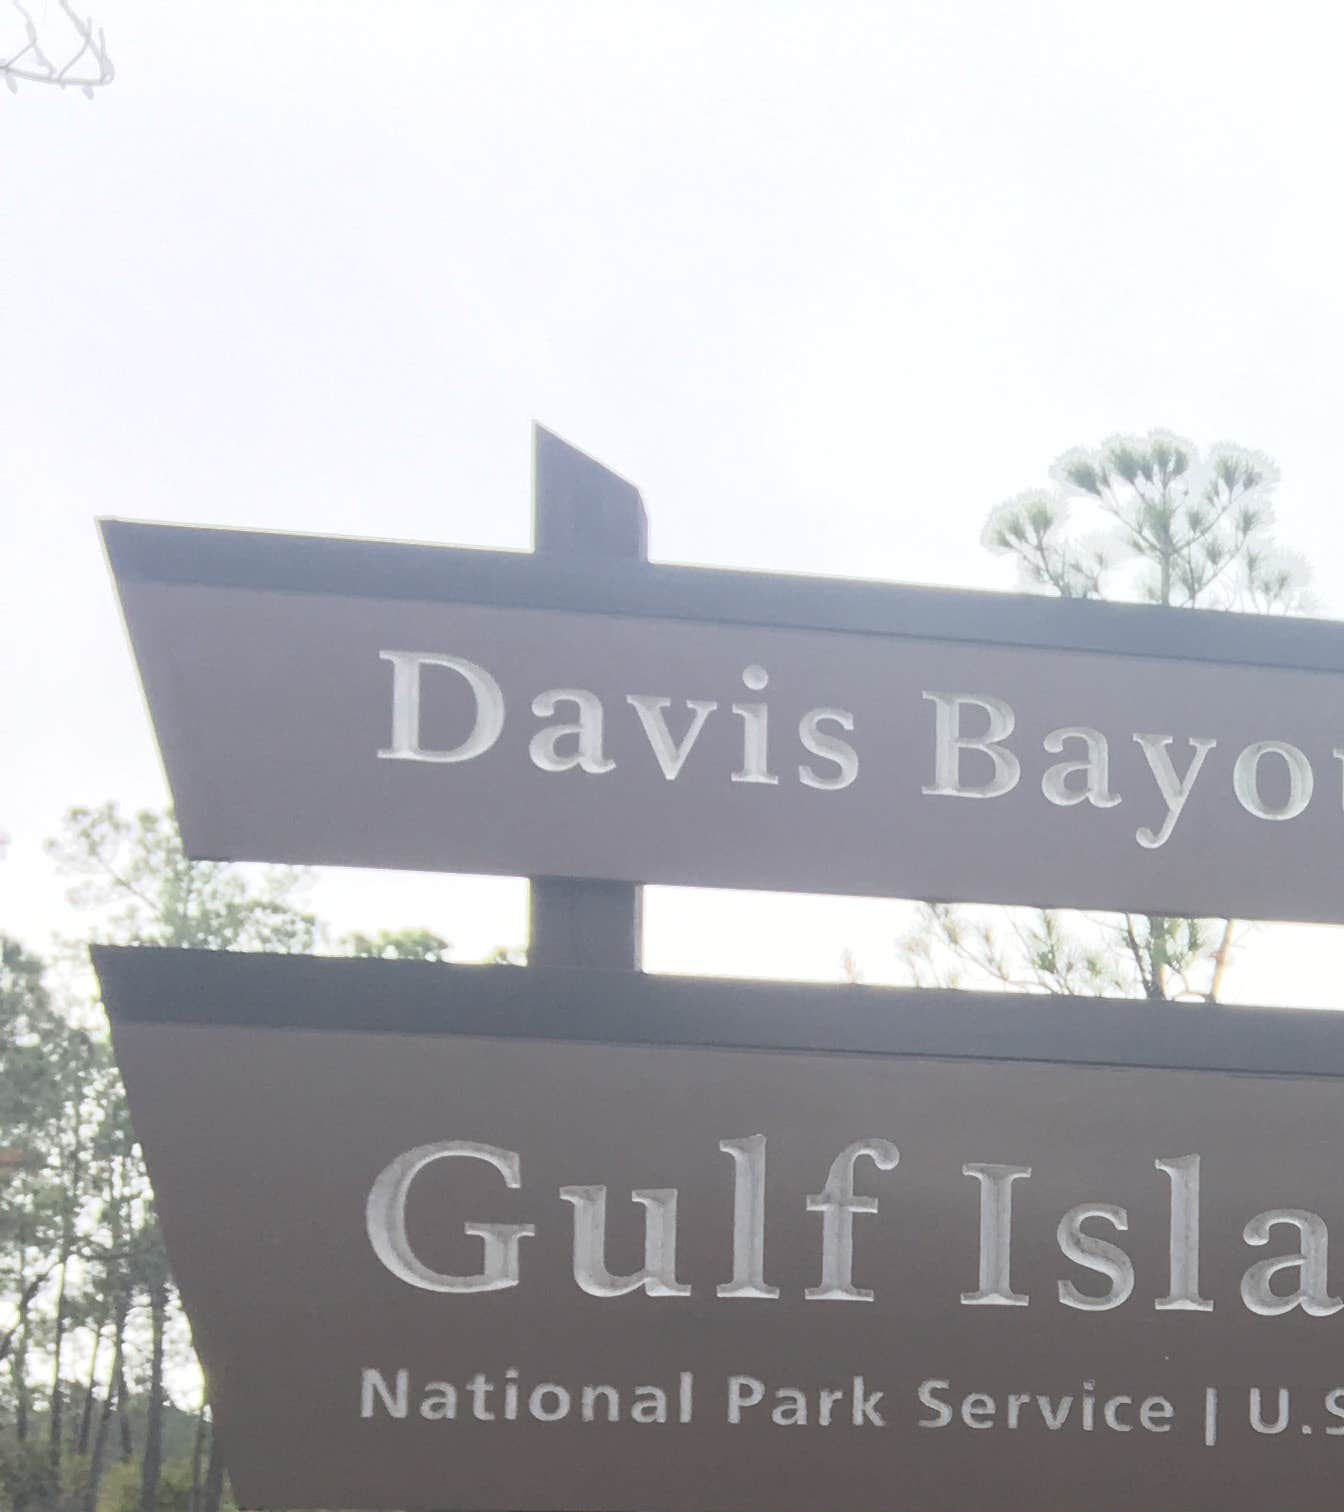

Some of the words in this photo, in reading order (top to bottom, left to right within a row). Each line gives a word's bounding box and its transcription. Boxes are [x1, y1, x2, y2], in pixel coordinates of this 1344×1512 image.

[378, 651, 859, 790] Davis
[367, 1133, 899, 1302] Gulf
[362, 1367, 692, 1423] National
[728, 1376, 884, 1426] Park
[918, 1381, 1173, 1432] Service
